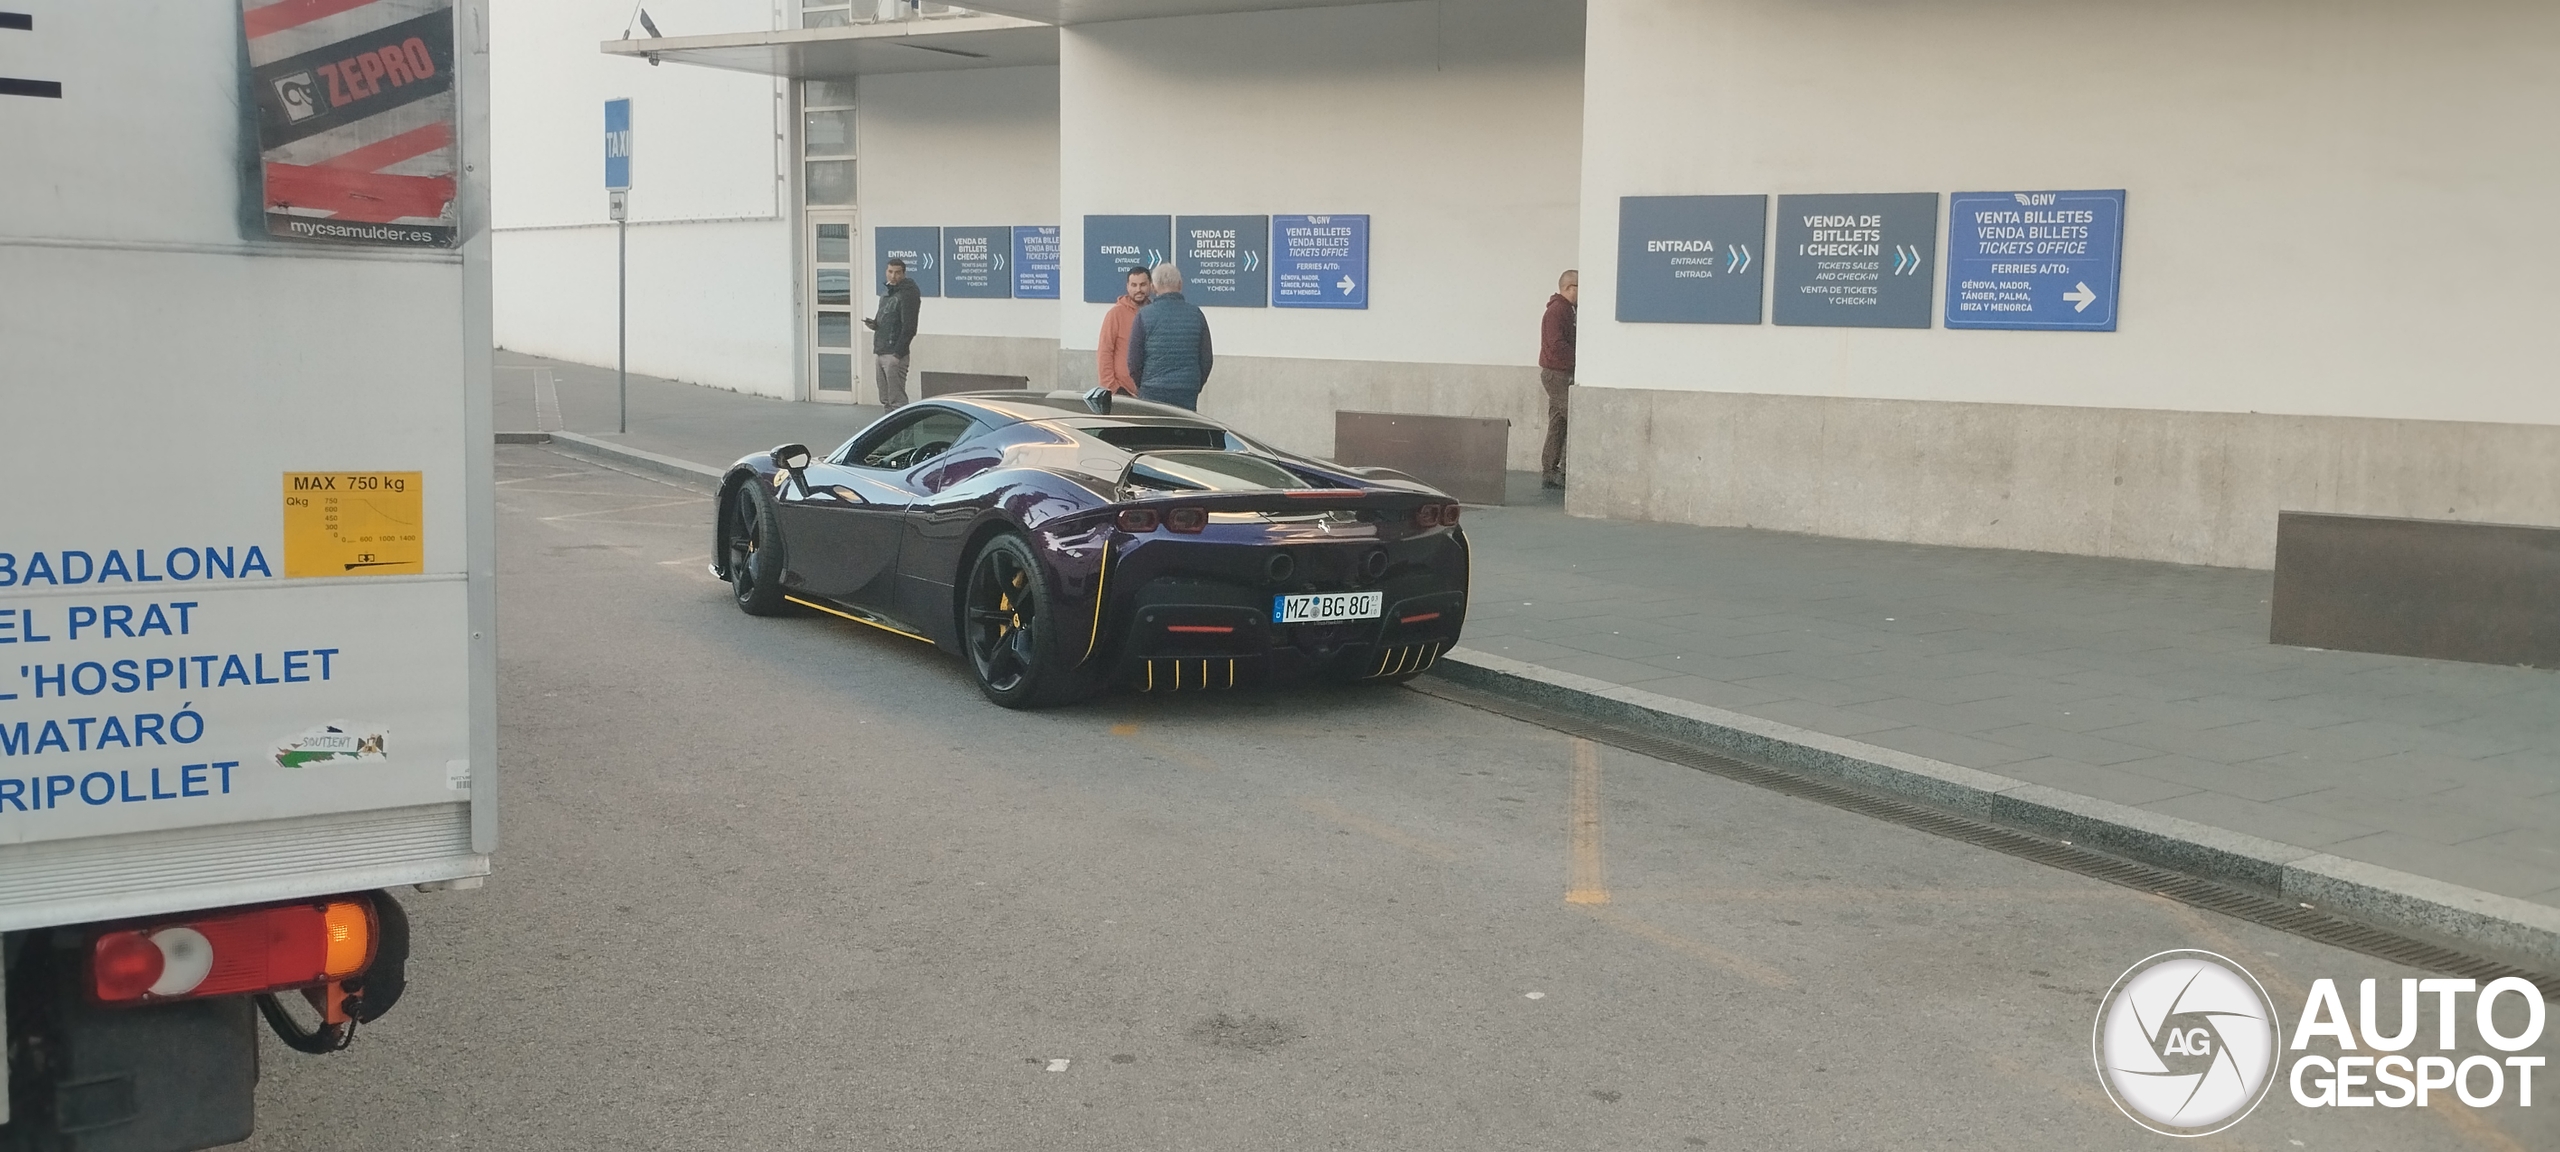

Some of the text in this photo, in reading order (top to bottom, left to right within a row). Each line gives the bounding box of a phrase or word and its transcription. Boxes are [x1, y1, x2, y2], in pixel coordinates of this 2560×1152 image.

[317, 37, 435, 108] ZEPRO
[606, 130, 629, 158] TAXI
[2031, 194, 2056, 206] GNV
[1316, 216, 1331, 225] GNV
[1803, 215, 1881, 227] VENDA DE
[1975, 211, 2093, 224] VENTA BILLETES
[291, 221, 432, 242] mycsamulder.es
[1191, 230, 1235, 238] VENDA DE
[1286, 227, 1351, 236] VENTA BILLETES
[1813, 230, 1880, 242] BITLLETS
[1977, 226, 2088, 239] VENDA BILLETS
[1197, 240, 1235, 248] BITLLETS
[1288, 238, 1349, 247] VENDA BILLETS
[1648, 241, 1713, 252] ENTRADA
[1979, 241, 2087, 254] TICKETS OFFICE
[1101, 246, 1140, 254] ENTRADA
[1189, 250, 1235, 258] I CHECK-IN
[1289, 248, 1349, 257] TICKETS OFFICE
[1800, 244, 1879, 256] I CHECK-IN
[1670, 257, 1713, 265] ENTRANCE
[1817, 262, 1879, 270] TICKETS SALES
[1991, 264, 2070, 274] FERRIES A/TO:
[1816, 273, 1878, 281] AND CHECK-IN
[1800, 286, 1878, 294] VENTA DE TICKETS
[1961, 279, 2032, 290] GÉNOVA, NADOR,
[1829, 297, 1877, 305] Y CHECK-IN
[1961, 290, 2031, 301] TÁNGER, PALMA,
[1960, 303, 2033, 312] IBIZA Y MENORCA
[294, 476, 405, 493] MAX 750 kg
[286, 497, 308, 508] Qkg
[0, 545, 272, 587] BADALONA
[1286, 596, 1370, 619] MZ BG 80
[68, 602, 198, 640] PRAT
[0, 702, 205, 756] MATARÓ
[0, 761, 239, 813] RIPOLLET
